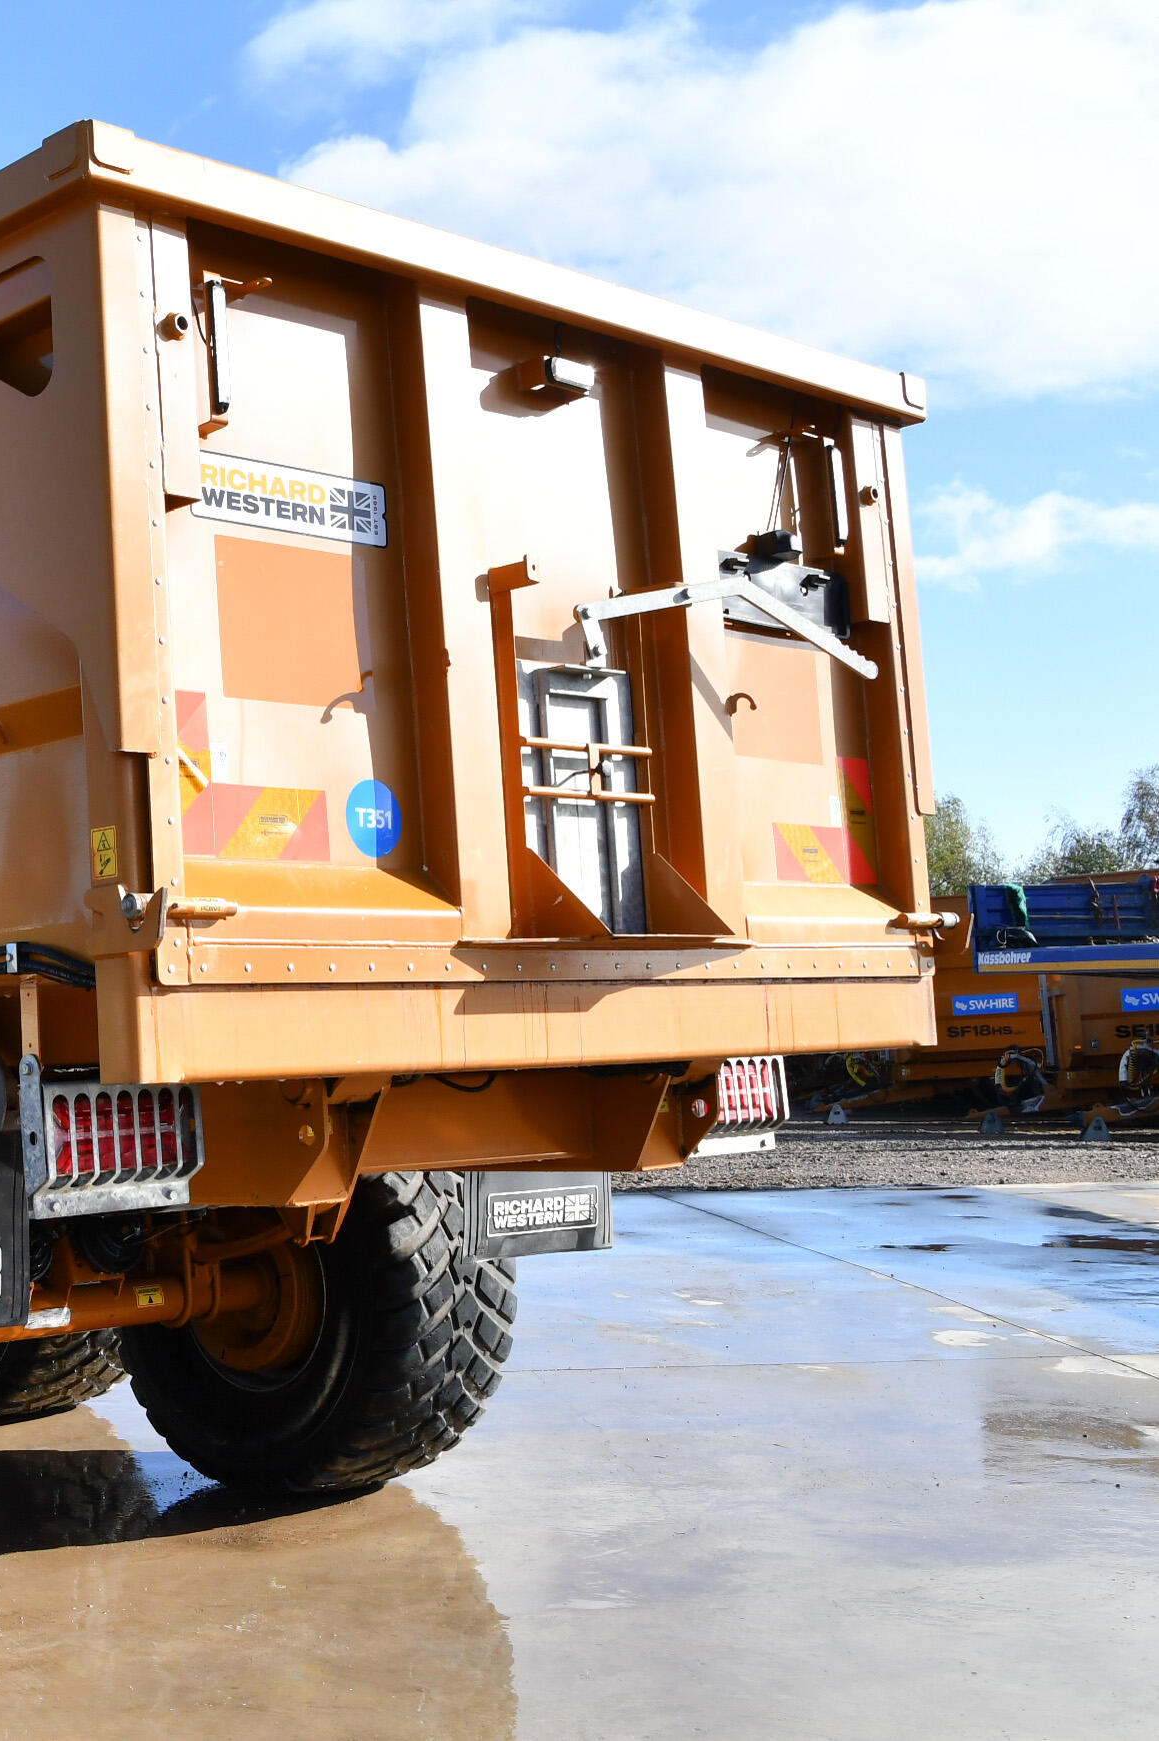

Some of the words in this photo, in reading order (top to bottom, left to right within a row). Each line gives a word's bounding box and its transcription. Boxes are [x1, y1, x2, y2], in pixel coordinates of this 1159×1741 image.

[200, 464, 326, 504] RICHARD
[201, 487, 326, 525] WESTERN
[355, 807, 392, 830] T351
[969, 998, 1015, 1010] SW-HIRE
[493, 1196, 564, 1216] RICHARD
[493, 1210, 564, 1229] WESTERN
